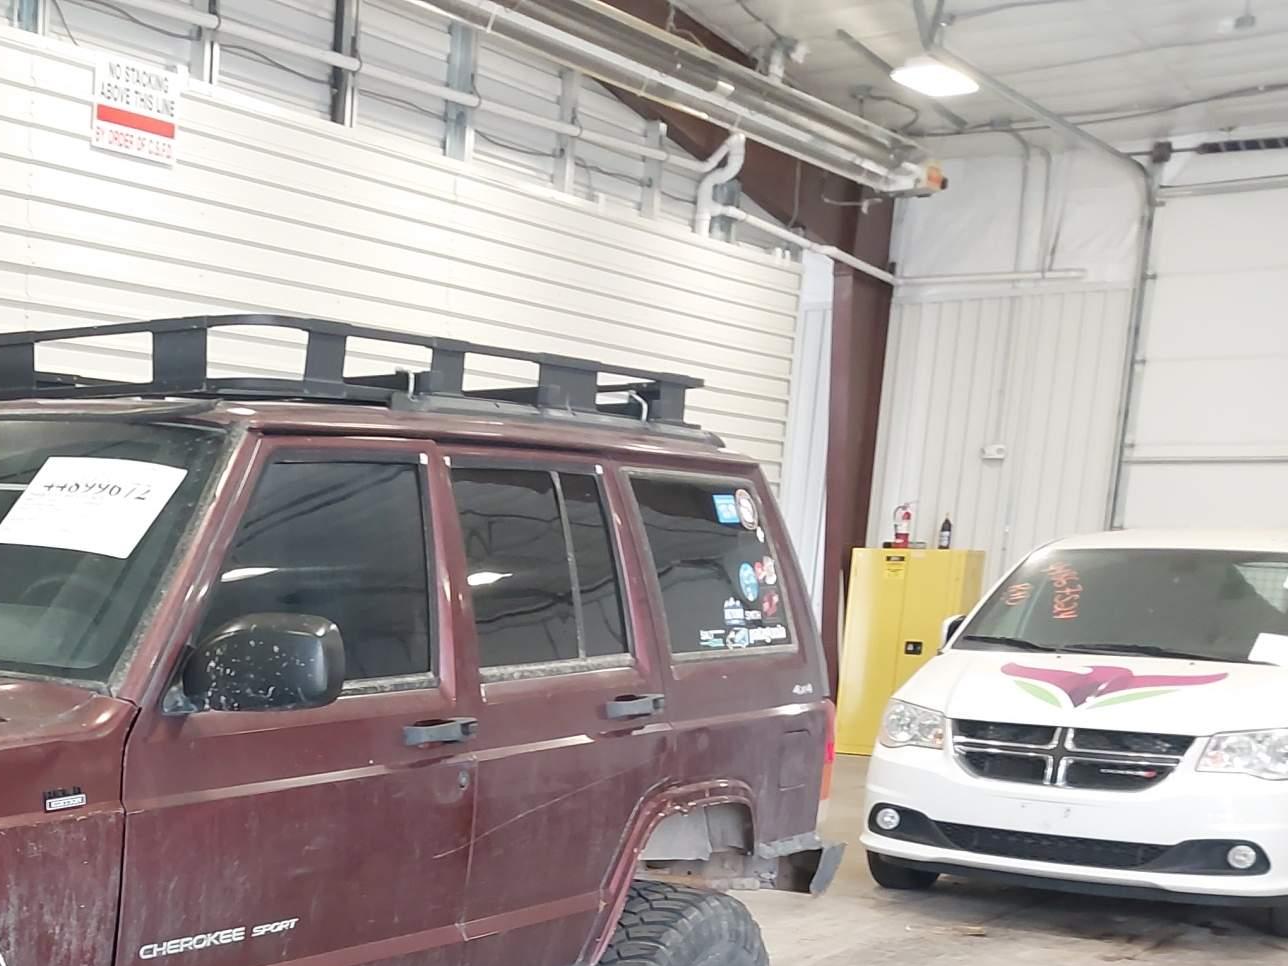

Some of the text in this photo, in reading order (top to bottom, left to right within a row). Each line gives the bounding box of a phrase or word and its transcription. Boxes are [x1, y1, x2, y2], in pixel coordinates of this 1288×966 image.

[108, 61, 169, 94] NO STACKING
[98, 81, 175, 118] ABOVE THIS LINE
[139, 917, 300, 960] CHEROKEE SPORT
